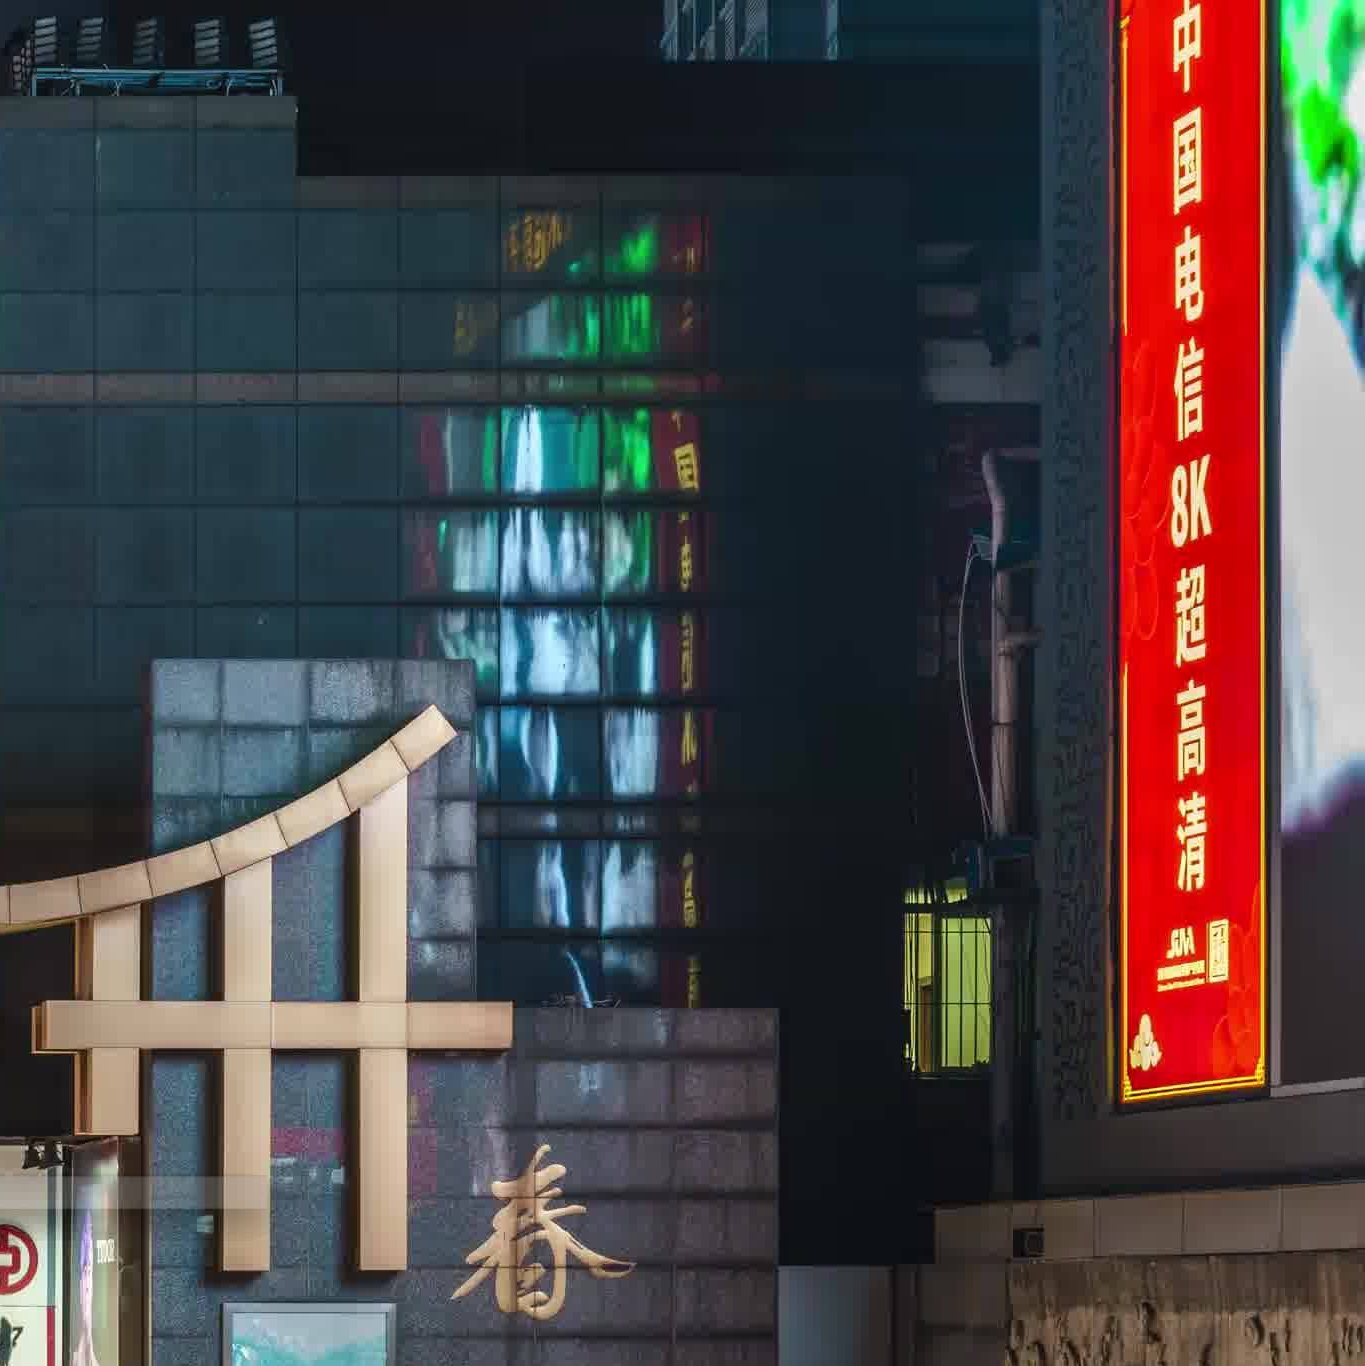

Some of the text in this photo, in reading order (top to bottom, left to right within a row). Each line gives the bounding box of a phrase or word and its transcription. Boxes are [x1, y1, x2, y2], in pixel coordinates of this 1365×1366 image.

[1170, 0, 1212, 892] 中国电信8K超高清
